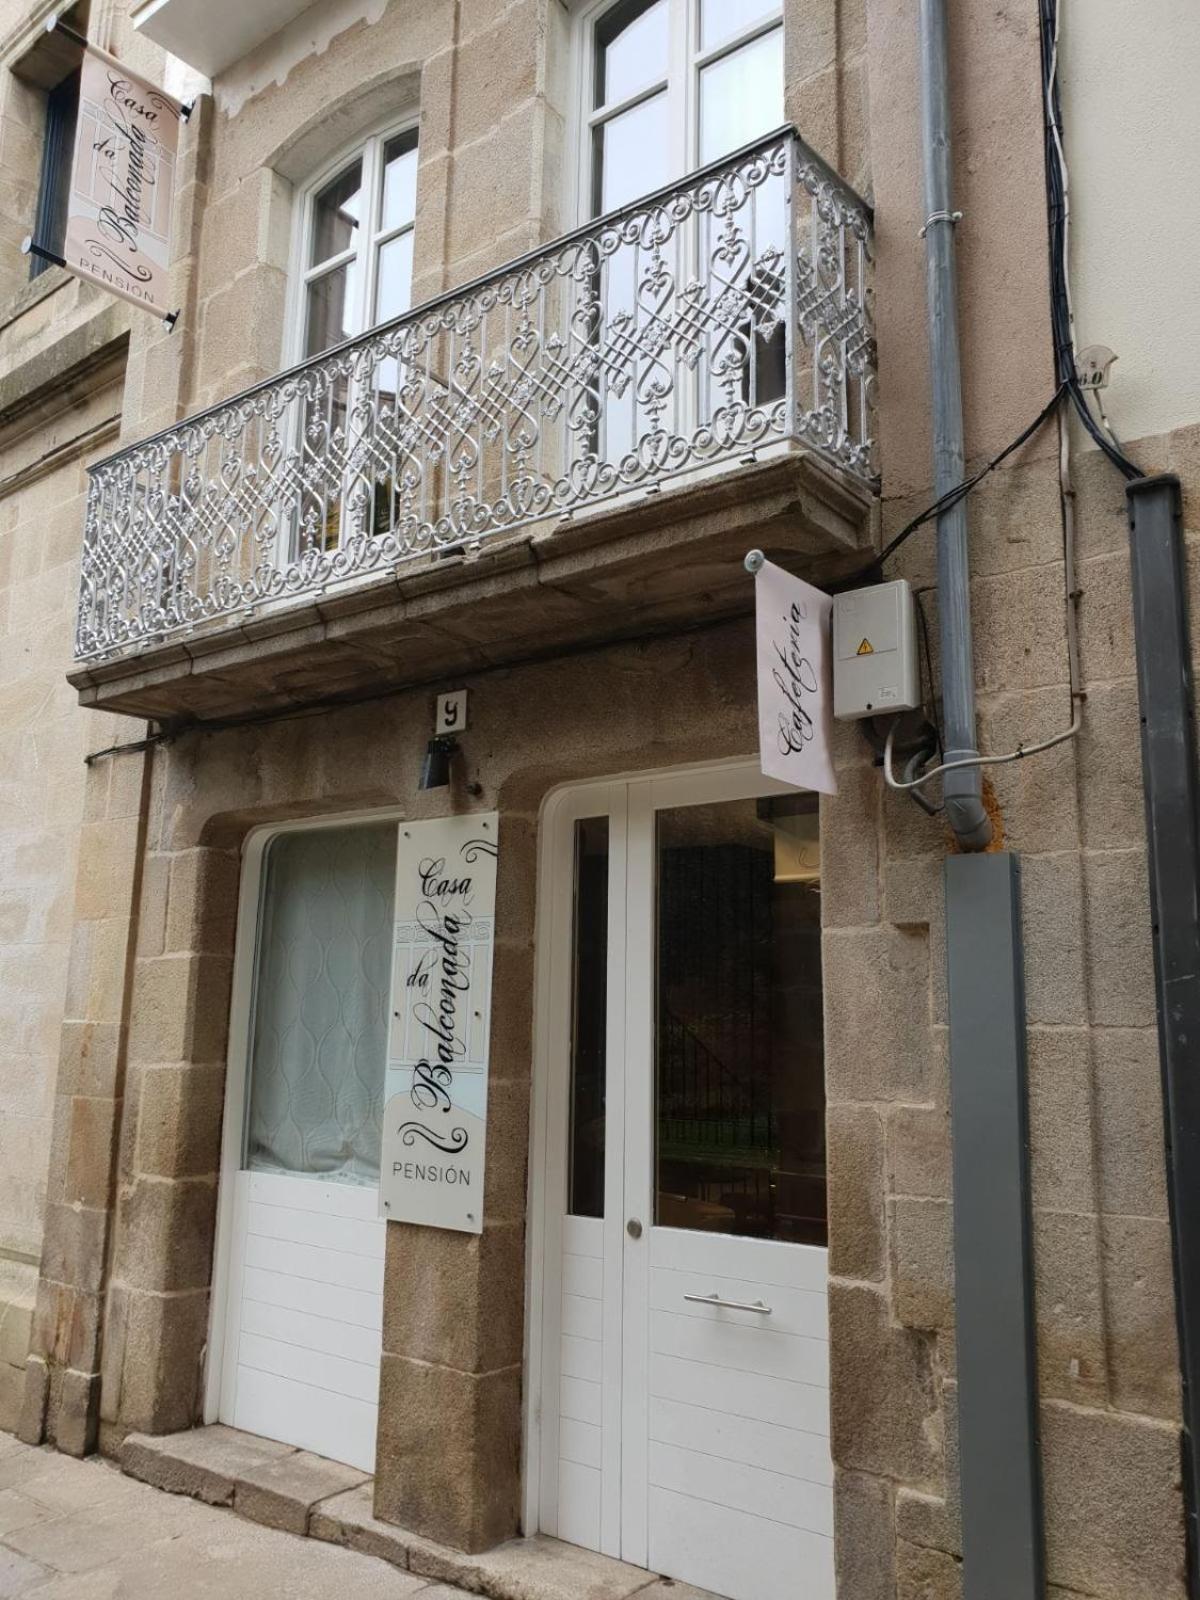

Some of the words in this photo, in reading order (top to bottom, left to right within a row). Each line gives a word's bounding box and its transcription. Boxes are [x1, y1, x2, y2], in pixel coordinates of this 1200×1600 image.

[106, 70, 158, 128] Casa
[93, 134, 125, 160] da
[97, 98, 158, 252] Balconada
[418, 857, 473, 906] Casa
[406, 950, 437, 995] da
[411, 901, 473, 1113] Balconada
[392, 1161, 471, 1187] PENSIÓN
